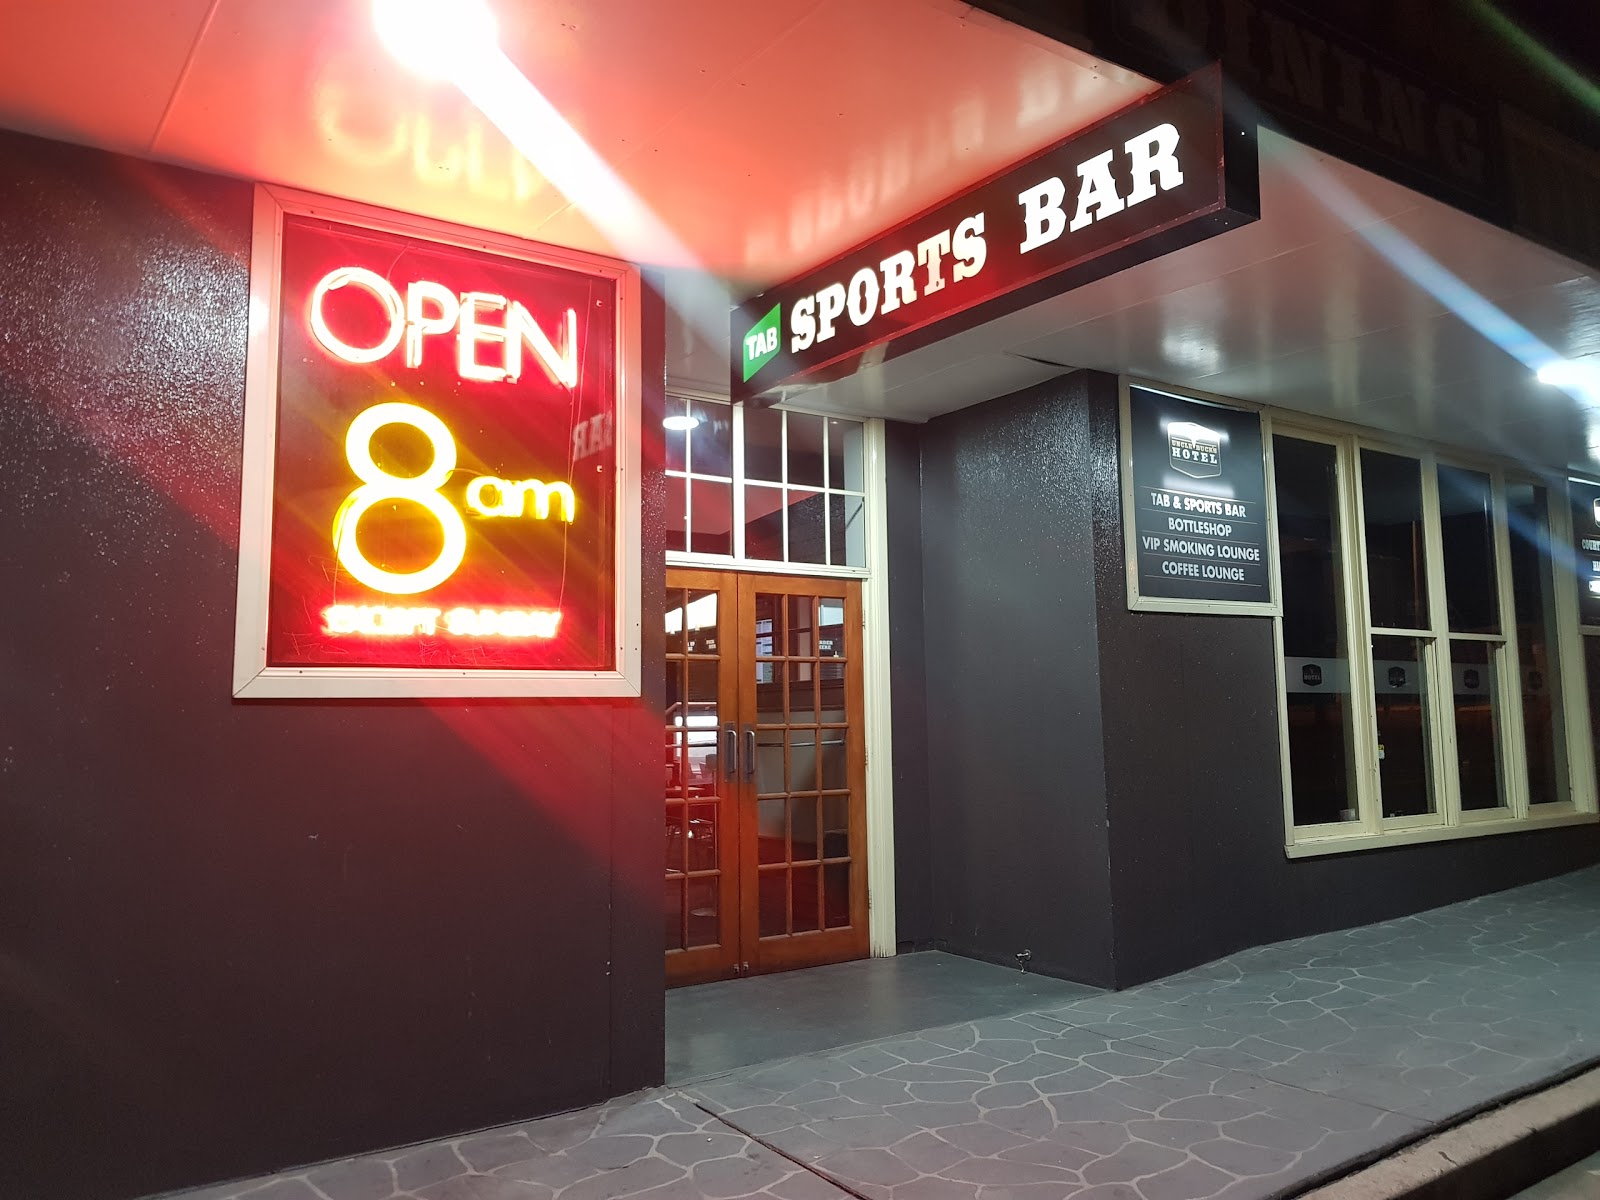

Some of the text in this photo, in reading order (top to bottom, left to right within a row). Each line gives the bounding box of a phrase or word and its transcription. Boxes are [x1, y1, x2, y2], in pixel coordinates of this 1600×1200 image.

[790, 122, 1185, 354] SPORTS BAR
[310, 266, 578, 389] OPEN
[746, 327, 778, 361] TAB
[1171, 446, 1218, 465] HOTEL
[332, 402, 576, 595] 8 am
[1150, 492, 1247, 518] TAB & SPORTS BAR
[1167, 517, 1232, 537] BOTTLESHOP
[1142, 536, 1260, 561] VIP SMOKING LOUNGE
[1162, 561, 1245, 581] COFFEE LOUNGE
